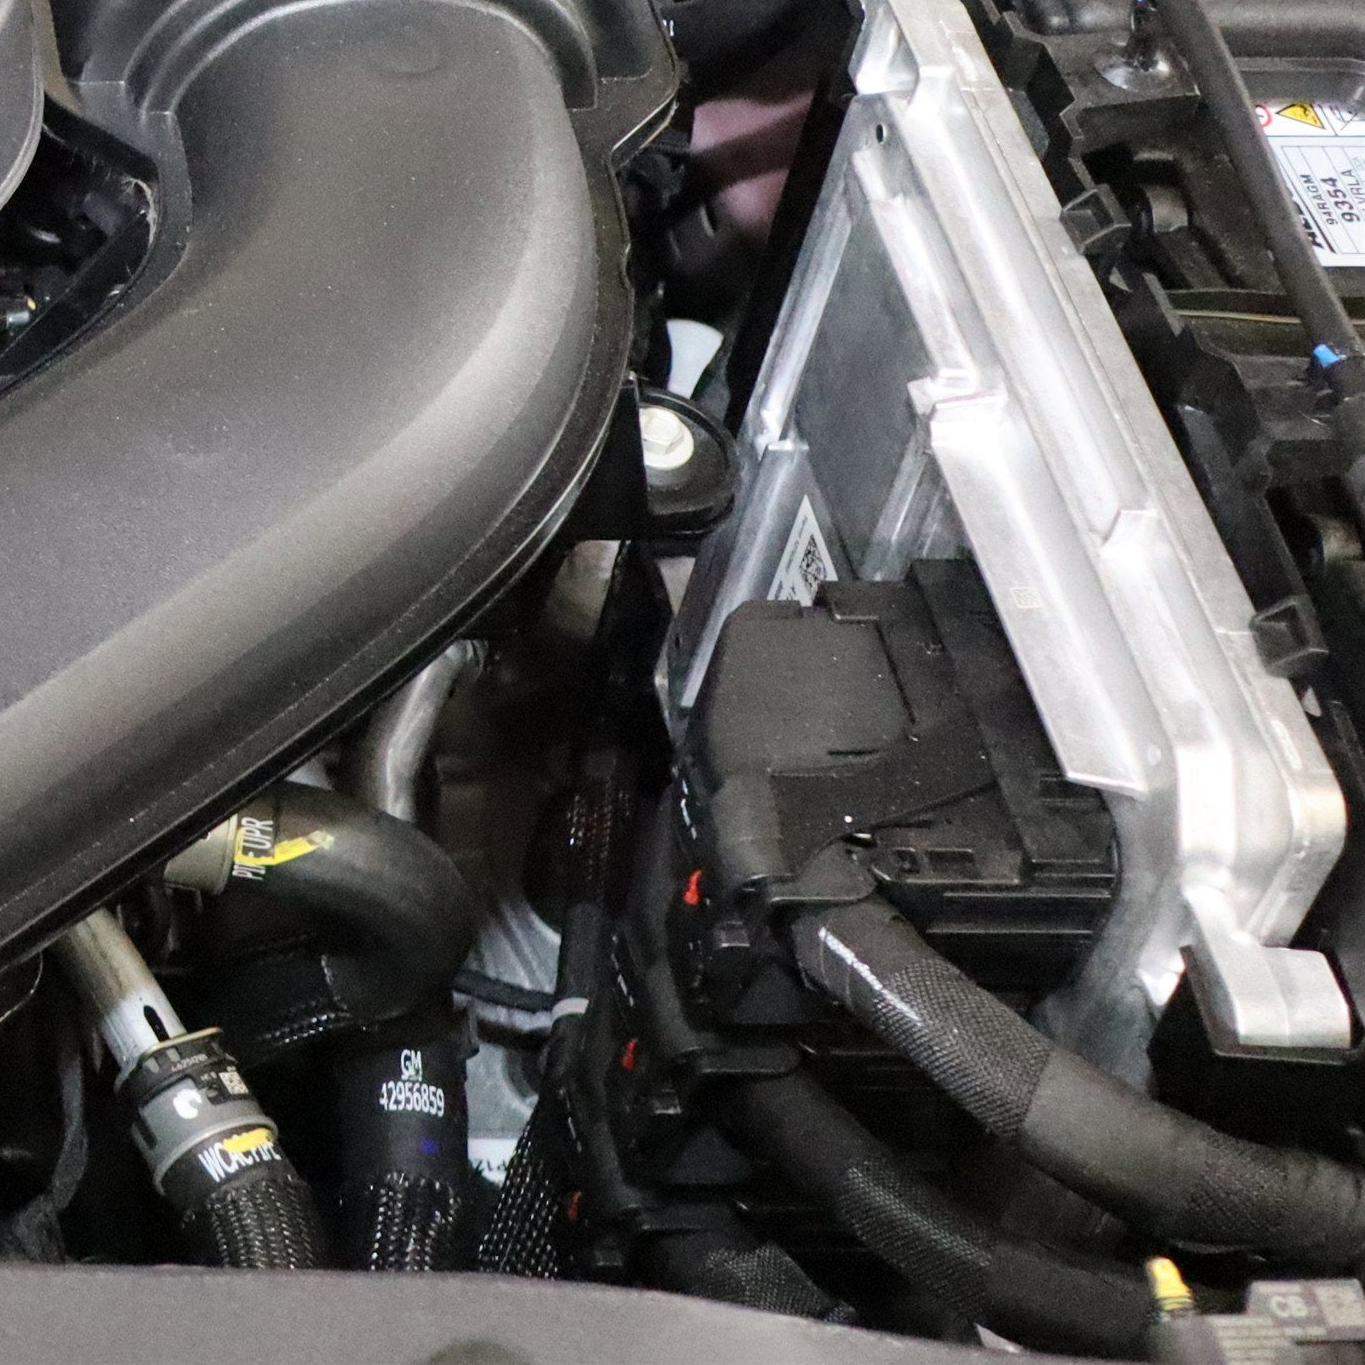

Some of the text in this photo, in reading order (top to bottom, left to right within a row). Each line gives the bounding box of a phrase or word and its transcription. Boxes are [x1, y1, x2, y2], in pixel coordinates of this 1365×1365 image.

[1320, 176, 1361, 222] 9354
[400, 1049, 423, 1081] GM
[379, 1081, 445, 1117] 42956859
